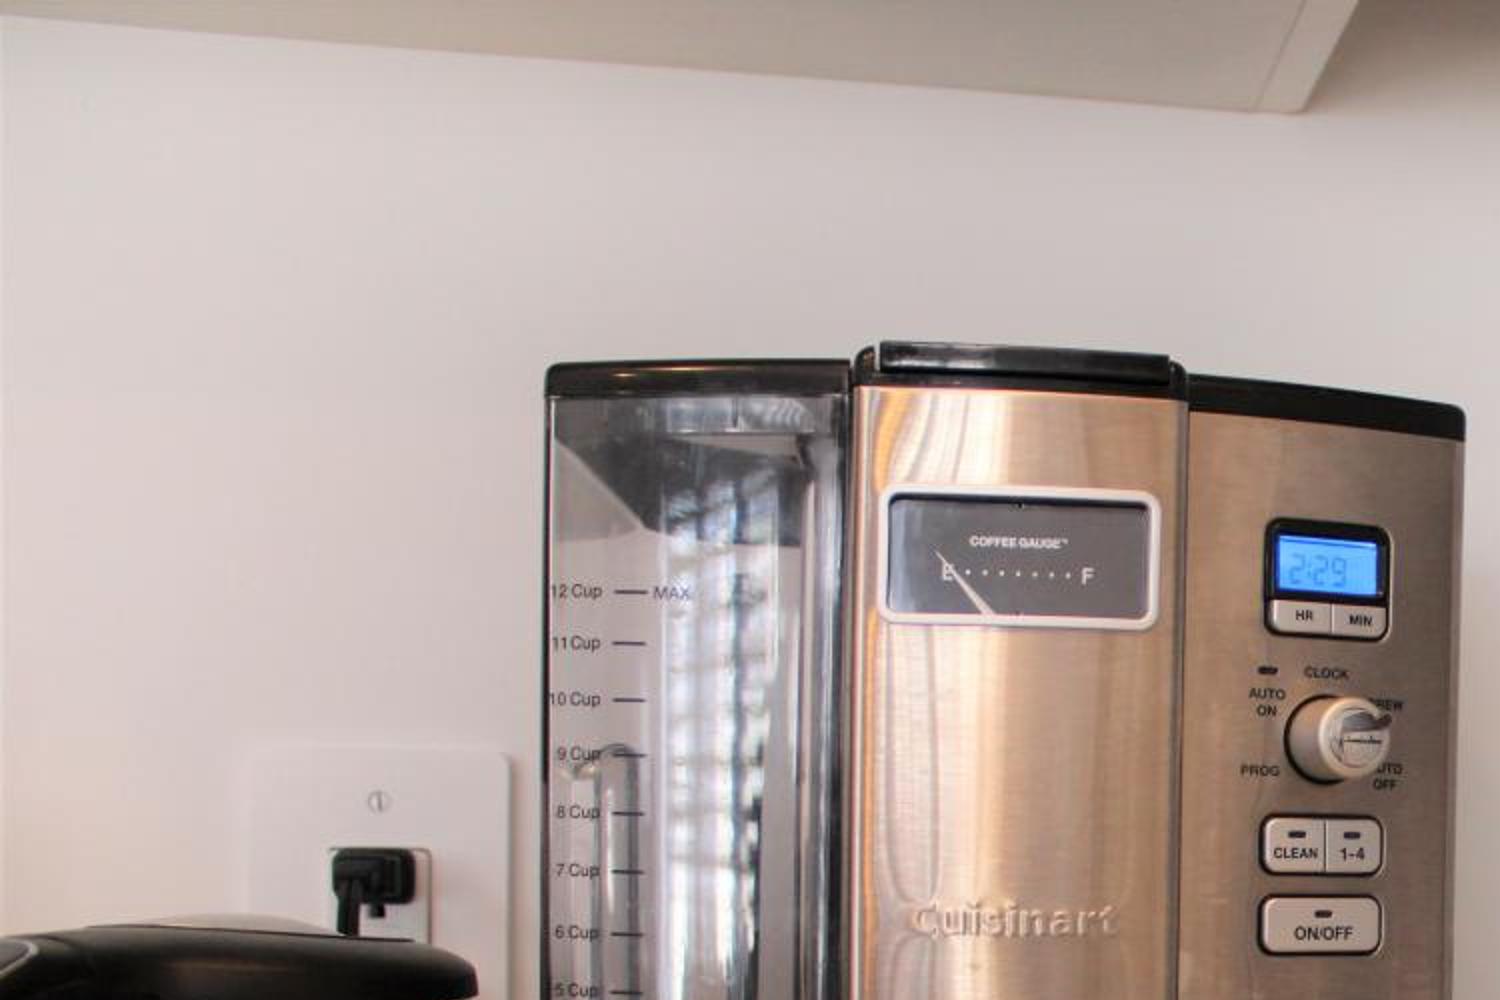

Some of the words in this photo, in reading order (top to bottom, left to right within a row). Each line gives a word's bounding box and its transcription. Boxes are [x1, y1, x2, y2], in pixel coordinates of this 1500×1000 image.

[968, 535, 1017, 548] COFFEE
[1081, 567, 1095, 585] F
[1288, 551, 1347, 588] 2:29
[552, 584, 568, 600] 12
[571, 583, 603, 601] Cup
[653, 585, 690, 600] MAX
[1295, 609, 1314, 621] HR
[1348, 614, 1373, 627] MIN
[552, 637, 568, 650] 11
[571, 635, 601, 652] Cup
[1304, 666, 1349, 680] CLOCK
[550, 692, 568, 706] 10
[570, 691, 601, 707] Cup
[1249, 687, 1286, 700] AUTO
[1257, 704, 1278, 717] ON
[557, 747, 567, 761] 9
[570, 746, 601, 762] Cup
[1241, 764, 1280, 777] PROG
[1376, 762, 1404, 775] UTO
[1373, 778, 1397, 791] OFF
[557, 805, 566, 820] 8
[569, 805, 601, 821] Cup
[1274, 847, 1319, 860] CLEAN
[1340, 847, 1366, 861] 1-4
[557, 863, 566, 877] 7
[568, 863, 600, 879] Cup
[912, 899, 1120, 939] Cuisinart
[555, 925, 565, 940] 6
[568, 925, 600, 942] Cup
[1294, 926, 1355, 942] ON/OFF
[554, 983, 565, 997] 5
[567, 983, 599, 999] Cup
